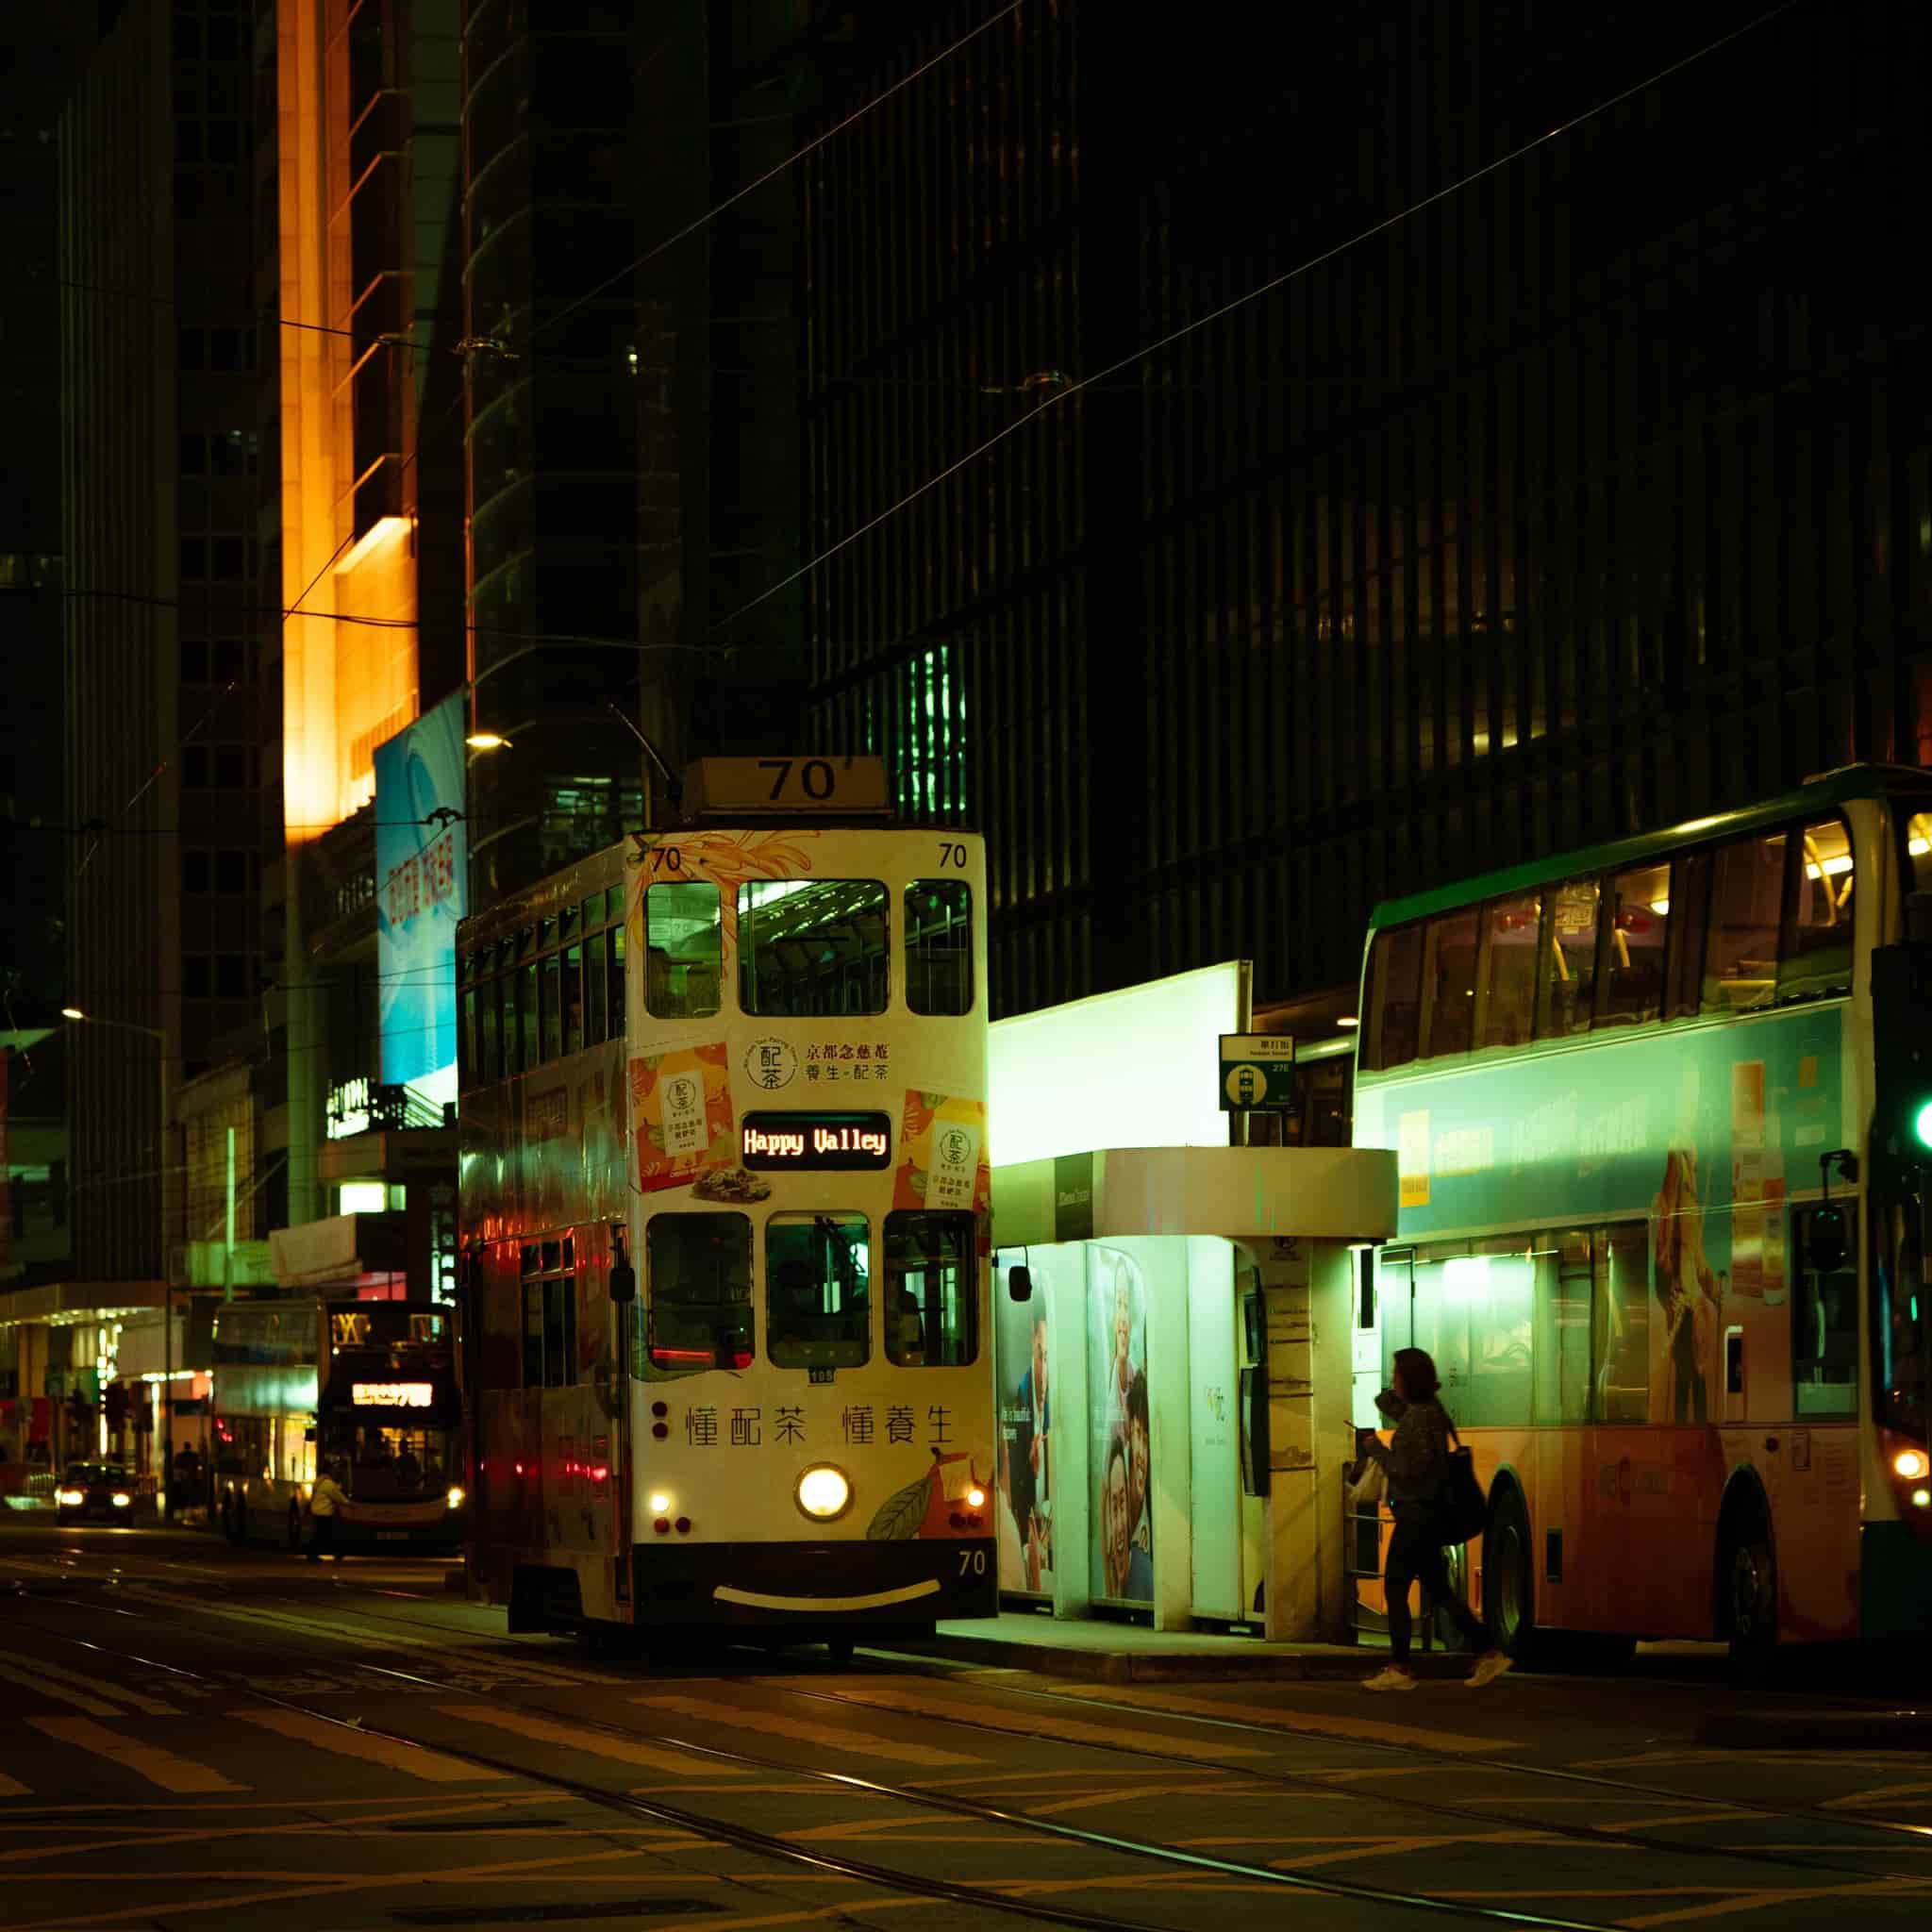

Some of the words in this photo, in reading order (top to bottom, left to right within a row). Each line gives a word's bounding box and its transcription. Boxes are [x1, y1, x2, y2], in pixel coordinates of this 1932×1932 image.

[758, 760, 836, 801] 70
[652, 847, 681, 873] 70
[938, 842, 968, 868] 70
[743, 1129, 804, 1156] Happy
[814, 1129, 887, 1156] Valley
[685, 1406, 808, 1446] 懂配茶
[841, 1404, 953, 1445] 懂養生
[957, 1550, 986, 1577] 70
